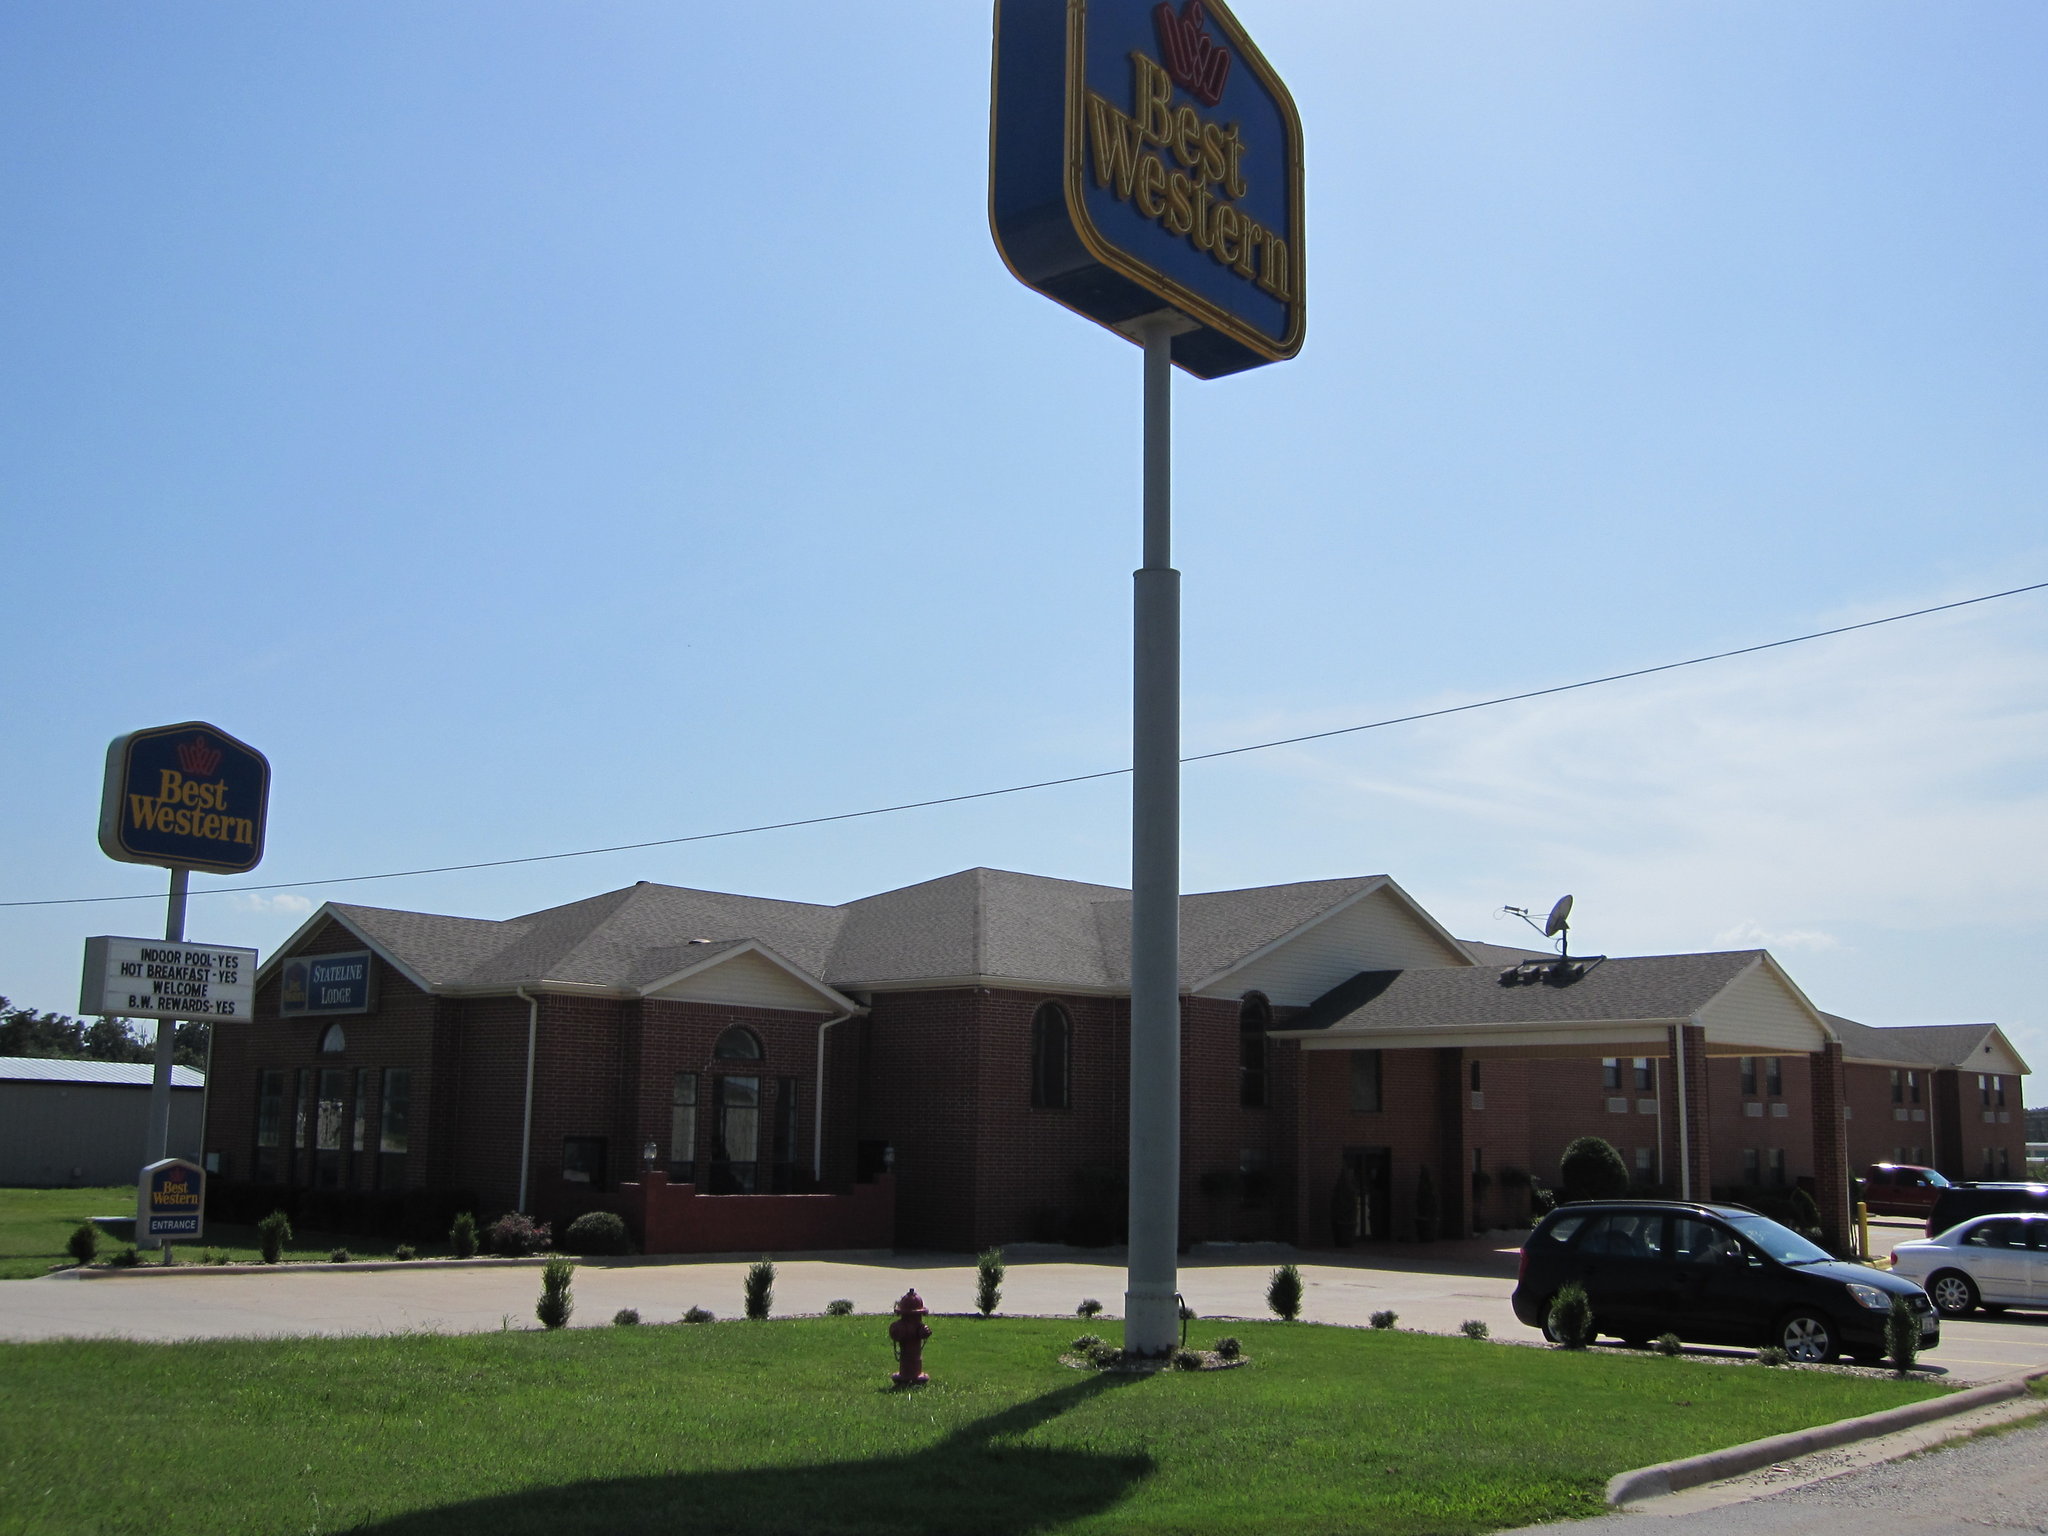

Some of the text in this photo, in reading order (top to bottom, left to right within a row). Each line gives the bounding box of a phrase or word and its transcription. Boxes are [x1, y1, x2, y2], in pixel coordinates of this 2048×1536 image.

[1131, 50, 1247, 200] Best
[1086, 88, 1291, 301] Western
[159, 769, 229, 811] Best
[129, 794, 253, 845] Western
[141, 948, 182, 965] INDOOR
[121, 962, 143, 977] HOT
[313, 964, 363, 984] STATELINE
[153, 981, 208, 997] WELCOME
[129, 995, 153, 1009] B.W.
[163, 1181, 189, 1194] Best
[153, 1191, 199, 1205] Western
[152, 1220, 196, 1230] ENTRANCE
